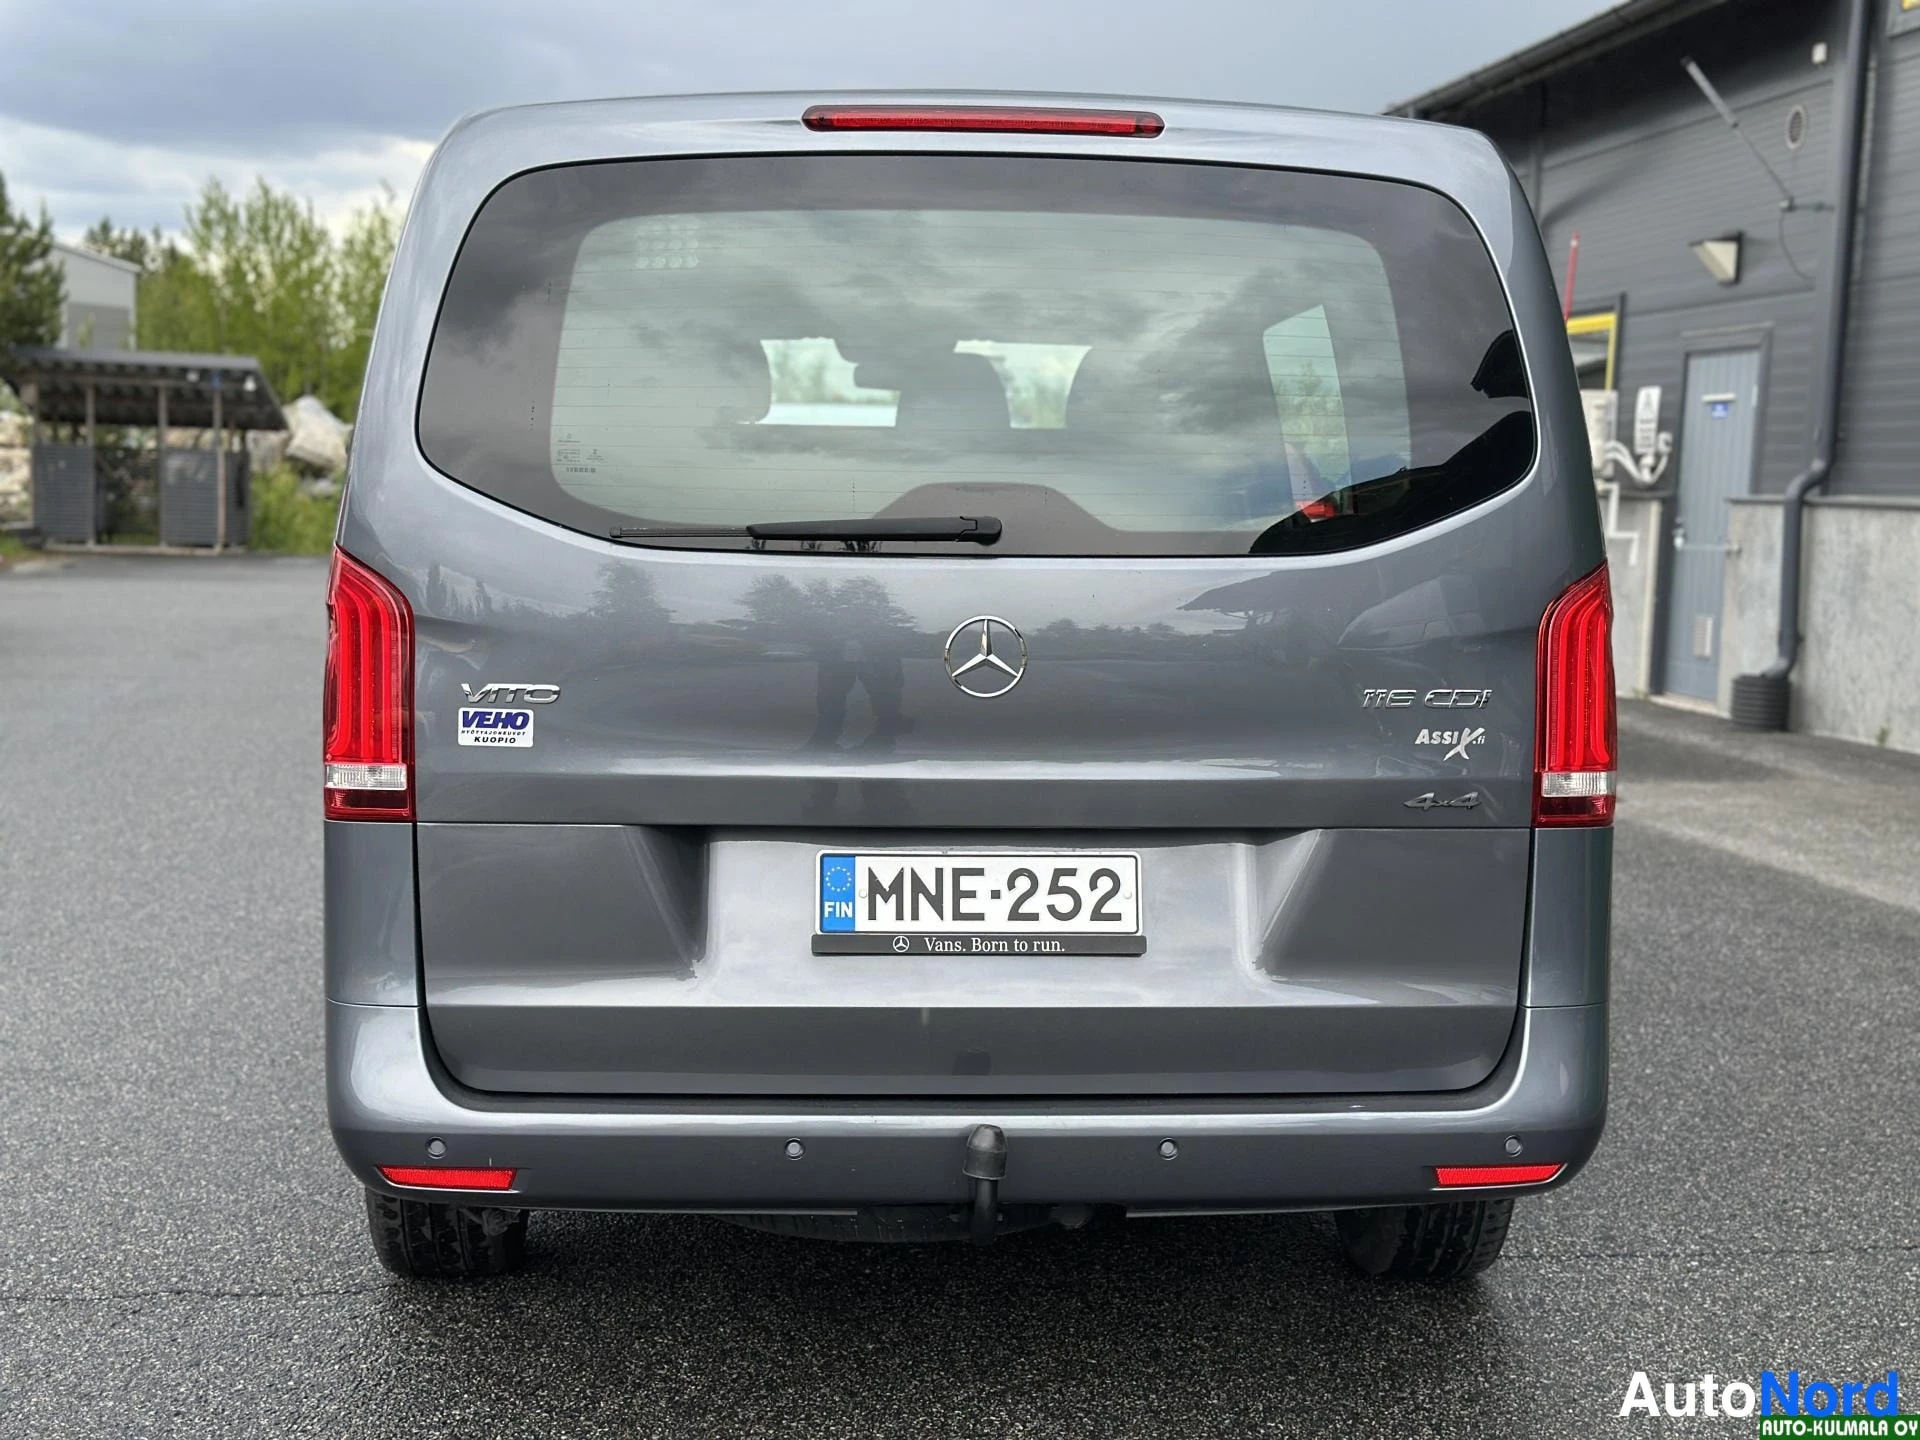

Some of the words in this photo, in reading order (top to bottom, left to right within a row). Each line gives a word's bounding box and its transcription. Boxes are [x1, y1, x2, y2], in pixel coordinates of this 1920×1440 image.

[461, 683, 561, 704] VITO
[1362, 689, 1417, 708] 116
[1424, 689, 1492, 708] CDI
[462, 711, 530, 730] VEHO
[1403, 792, 1481, 811] 4x4
[867, 866, 1122, 922] MNE-252
[824, 901, 853, 918] FIN
[924, 937, 966, 952] Vans.
[972, 937, 1008, 952] Born
[1014, 938, 1028, 952] to
[1034, 940, 1065, 952] run.
